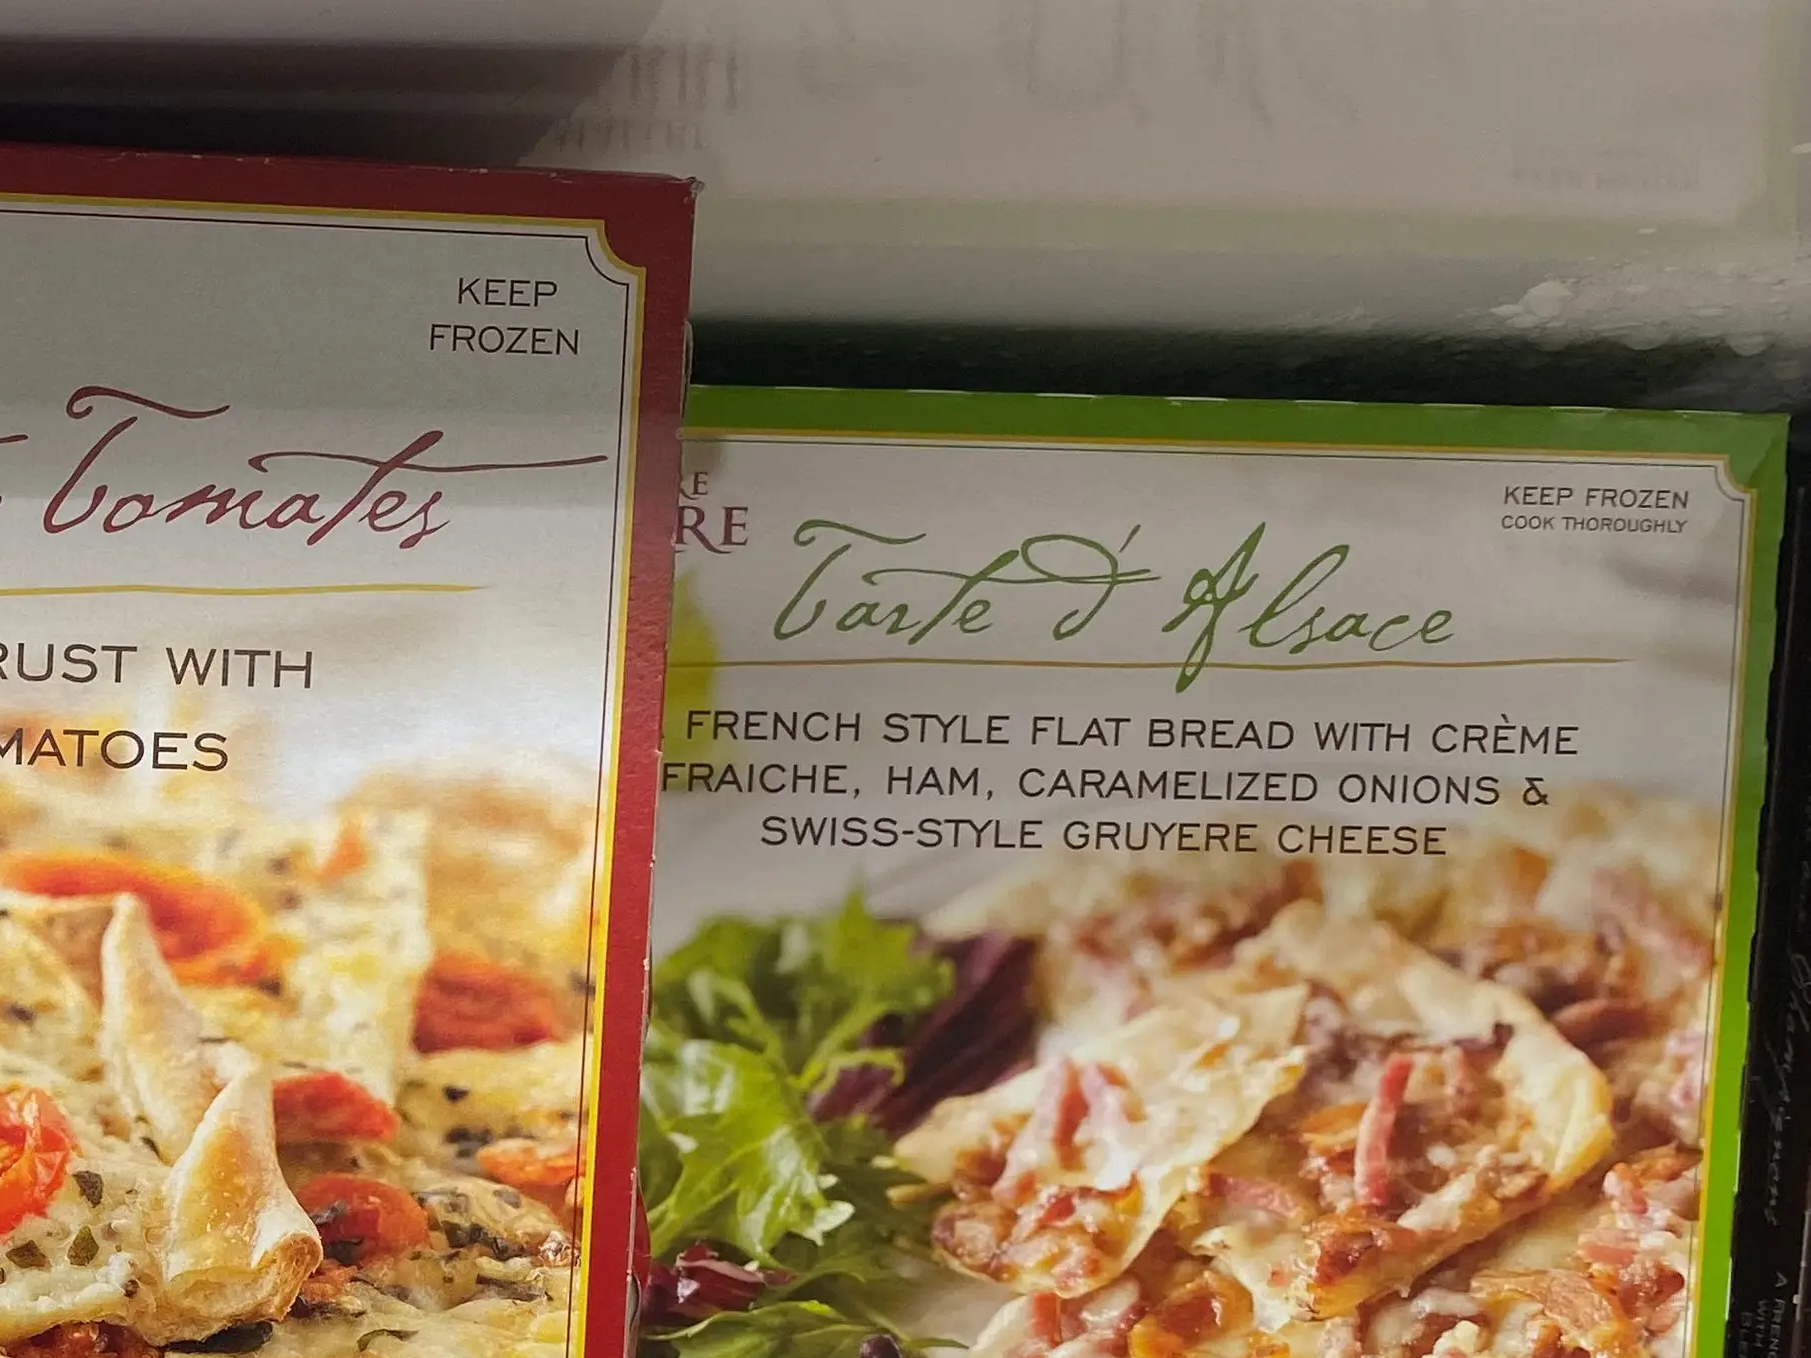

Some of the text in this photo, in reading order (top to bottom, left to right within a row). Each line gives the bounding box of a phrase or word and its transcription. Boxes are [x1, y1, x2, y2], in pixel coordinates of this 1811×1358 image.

[456, 277, 559, 307] KEEP
[429, 324, 580, 356] FROZEN
[42, 385, 609, 549] Tomates
[1504, 486, 1689, 510] KEEP FROZEN
[1501, 515, 1689, 534] COOK THOROUGHLY
[774, 519, 1149, 646] Tarte
[686, 709, 1580, 756] FRENCH STYLE FLAT BREAD WITH CRÈME
[661, 762, 1550, 806] FRAICHE, HAM, CARAMELIZED ONIONS &
[760, 815, 1448, 856] SWISS-STYLE GRUYERE CHEESE
